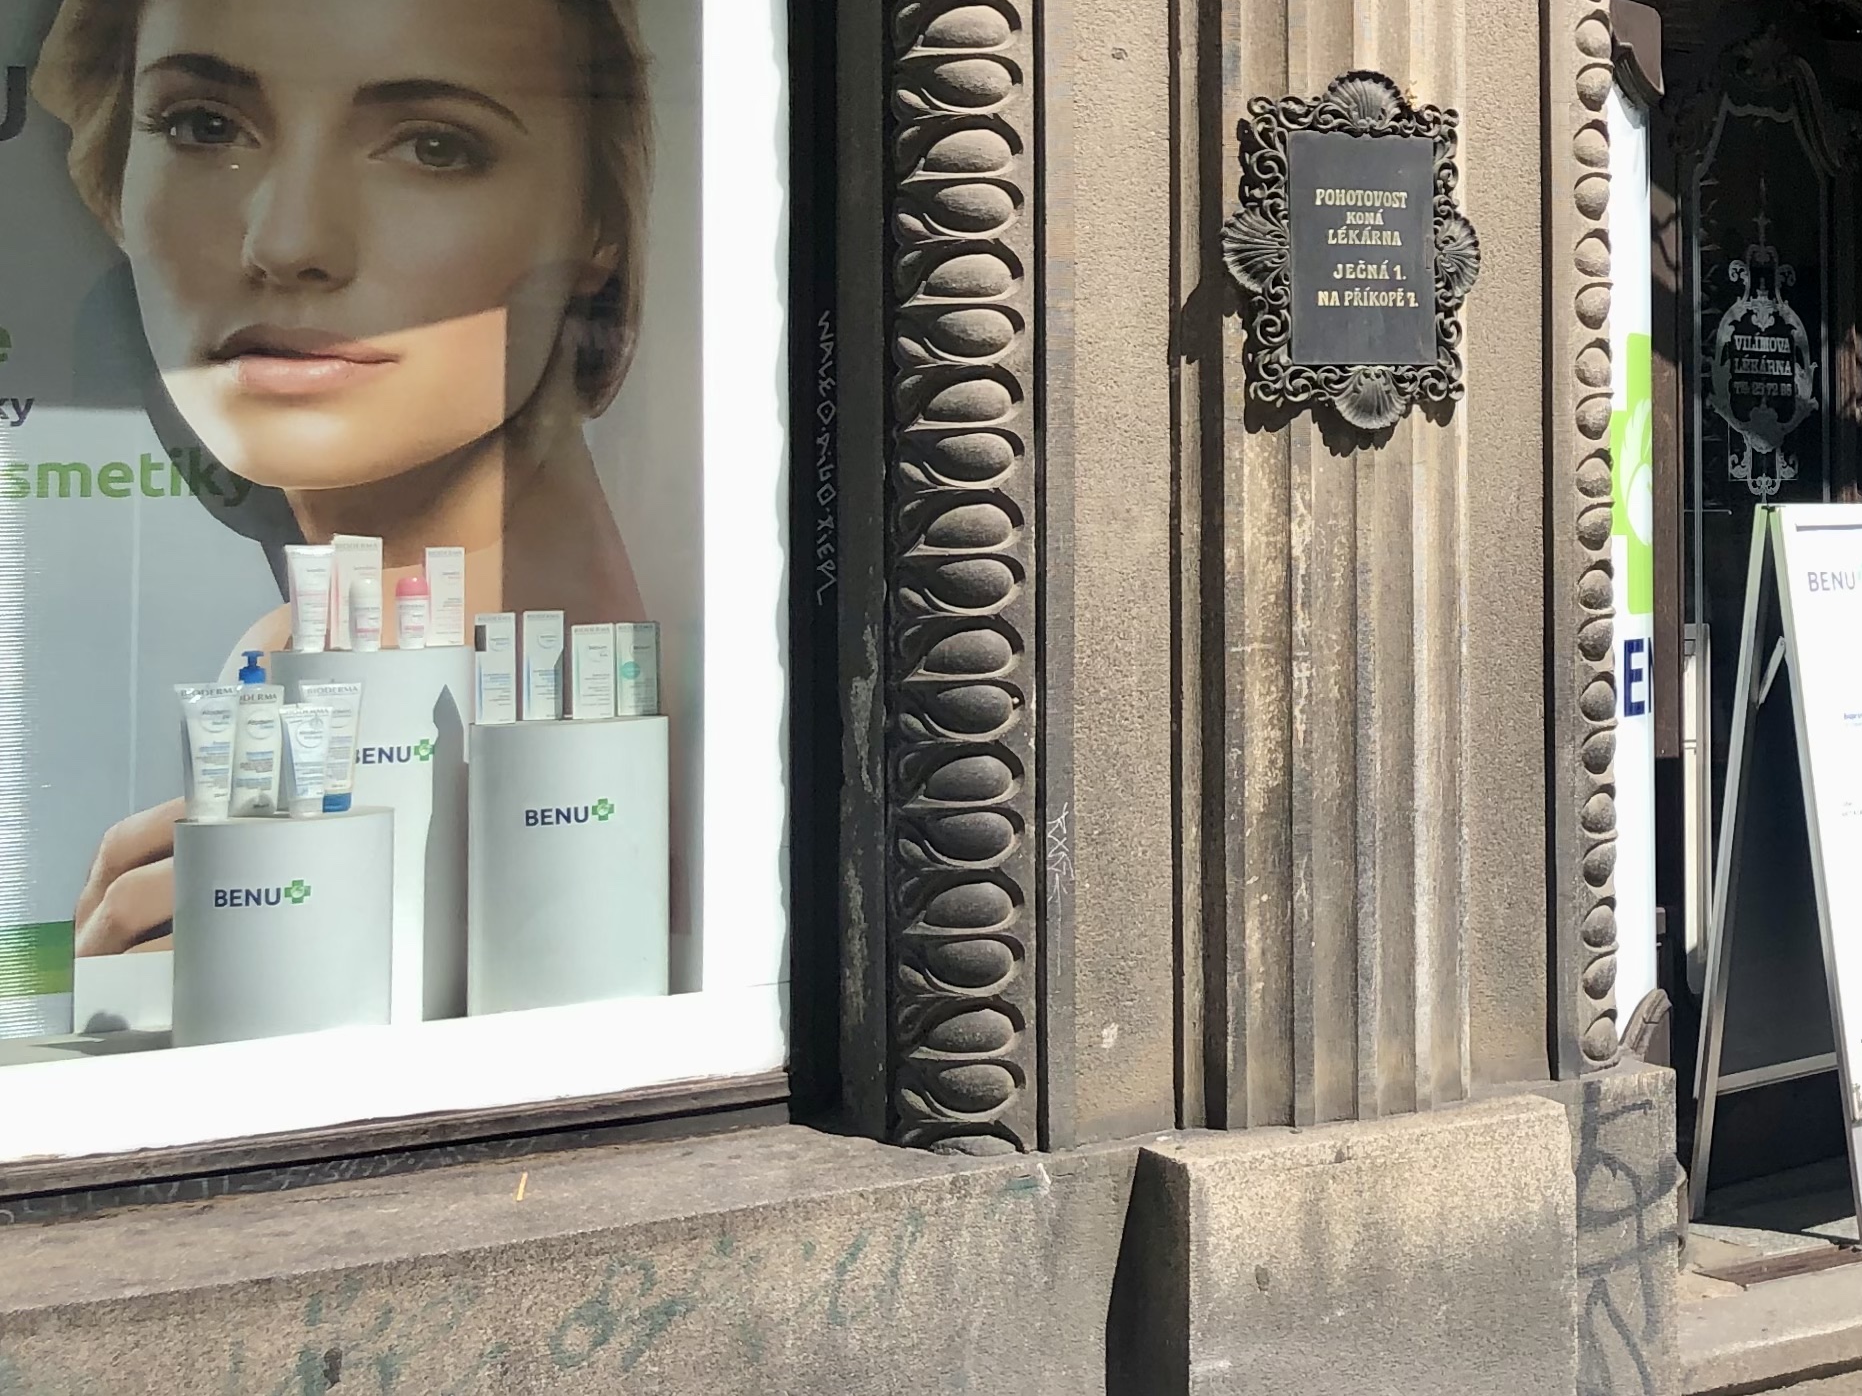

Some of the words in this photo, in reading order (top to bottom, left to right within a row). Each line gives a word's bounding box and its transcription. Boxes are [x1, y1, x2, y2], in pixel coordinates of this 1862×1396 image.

[1315, 189, 1407, 208] POHOTOVOST
[1346, 209, 1384, 225] KONÁ
[1328, 226, 1402, 246] LÉKÁRNA
[1333, 260, 1390, 280] JEČNÁ
[1317, 291, 1340, 306] NA
[1344, 287, 1404, 307] PŘÍKOPĚ
[1807, 571, 1856, 592] BENU
[1624, 637, 1653, 718] E
[525, 806, 589, 827] BENU
[214, 886, 282, 907] BENU
